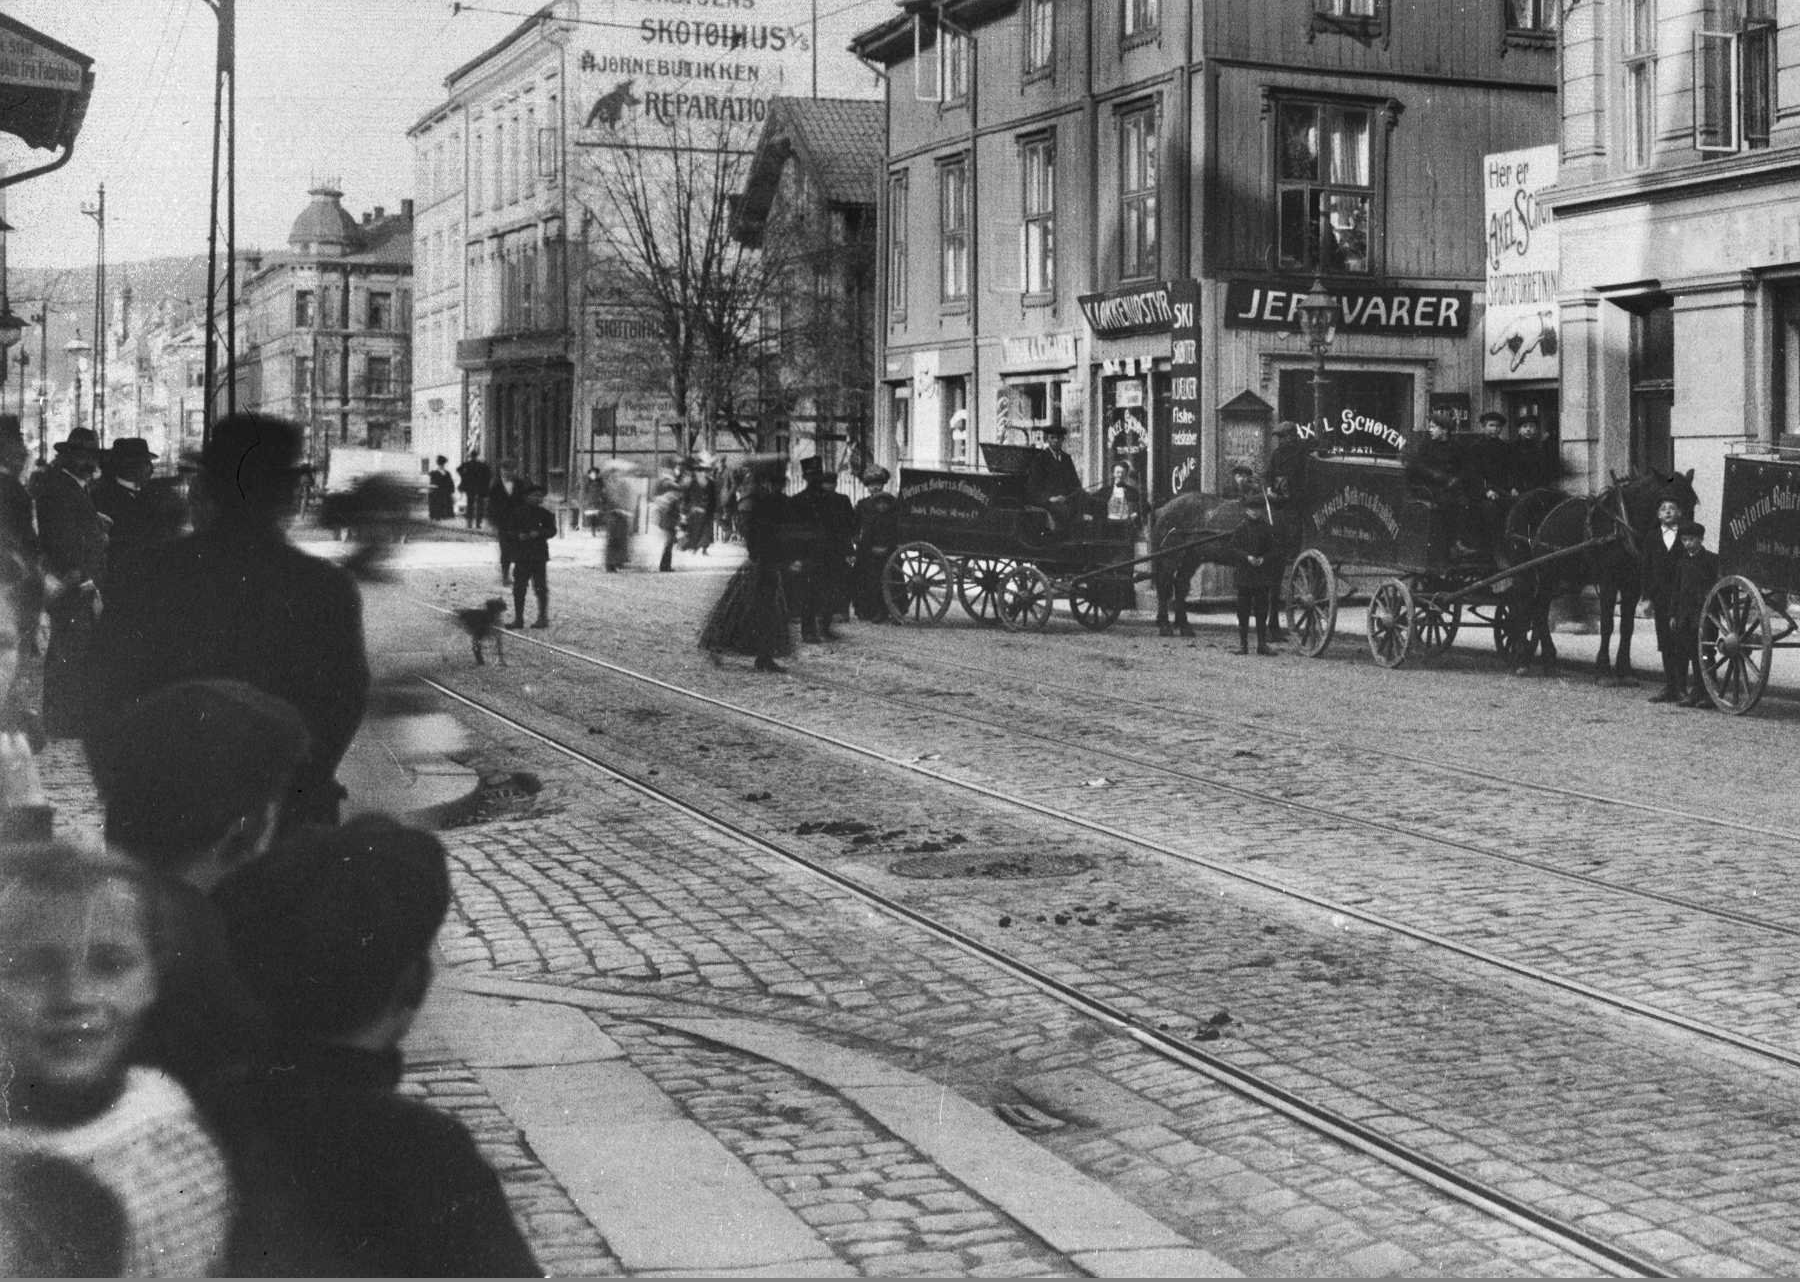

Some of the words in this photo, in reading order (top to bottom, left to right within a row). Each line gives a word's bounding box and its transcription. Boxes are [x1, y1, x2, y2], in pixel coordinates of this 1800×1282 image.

[641, 18, 786, 51] SKOTØIHUS
[1489, 161, 1511, 189] Her
[1516, 161, 1529, 185] er
[1173, 303, 1194, 328] SKI
[1341, 409, 1407, 451] SCHØYEN
